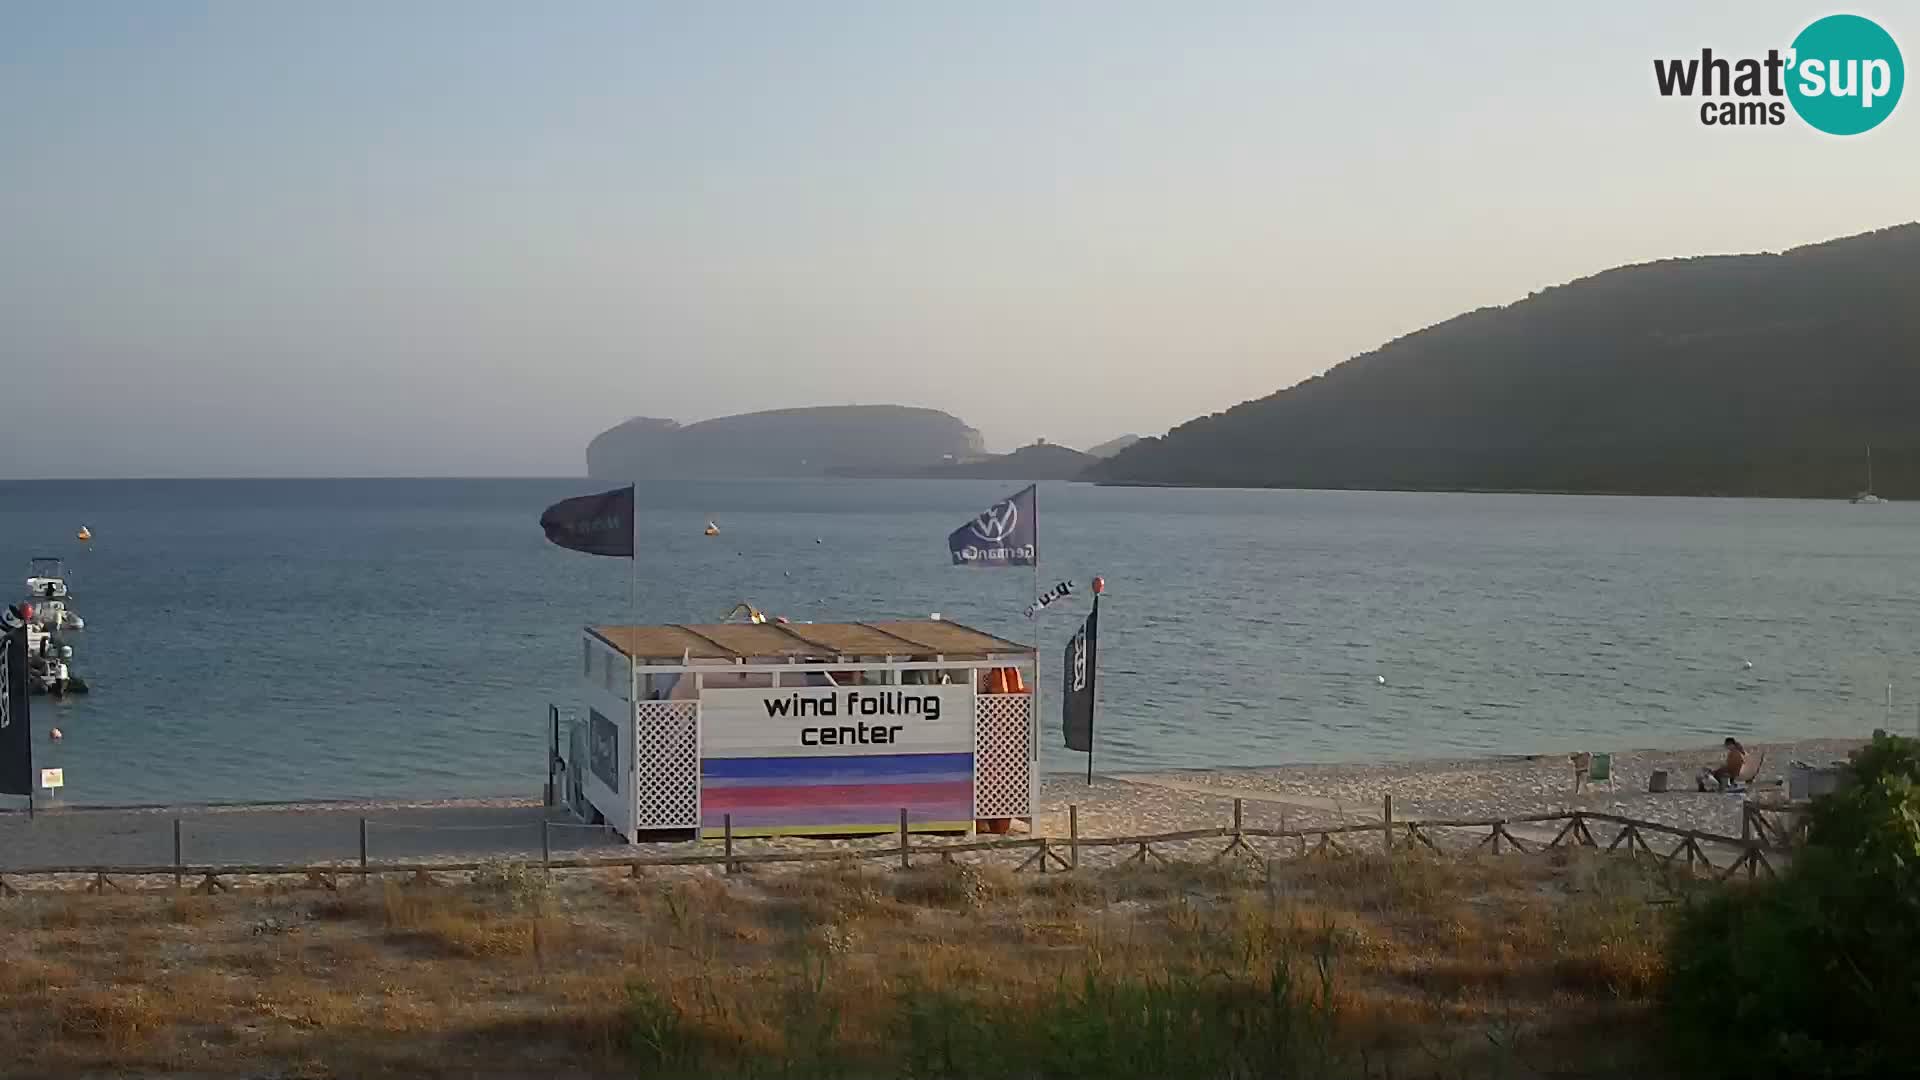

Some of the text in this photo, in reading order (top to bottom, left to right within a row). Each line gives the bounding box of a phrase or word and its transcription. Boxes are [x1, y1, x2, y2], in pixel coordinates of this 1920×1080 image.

[764, 691, 940, 720] wind foiling
[802, 722, 903, 746] center
